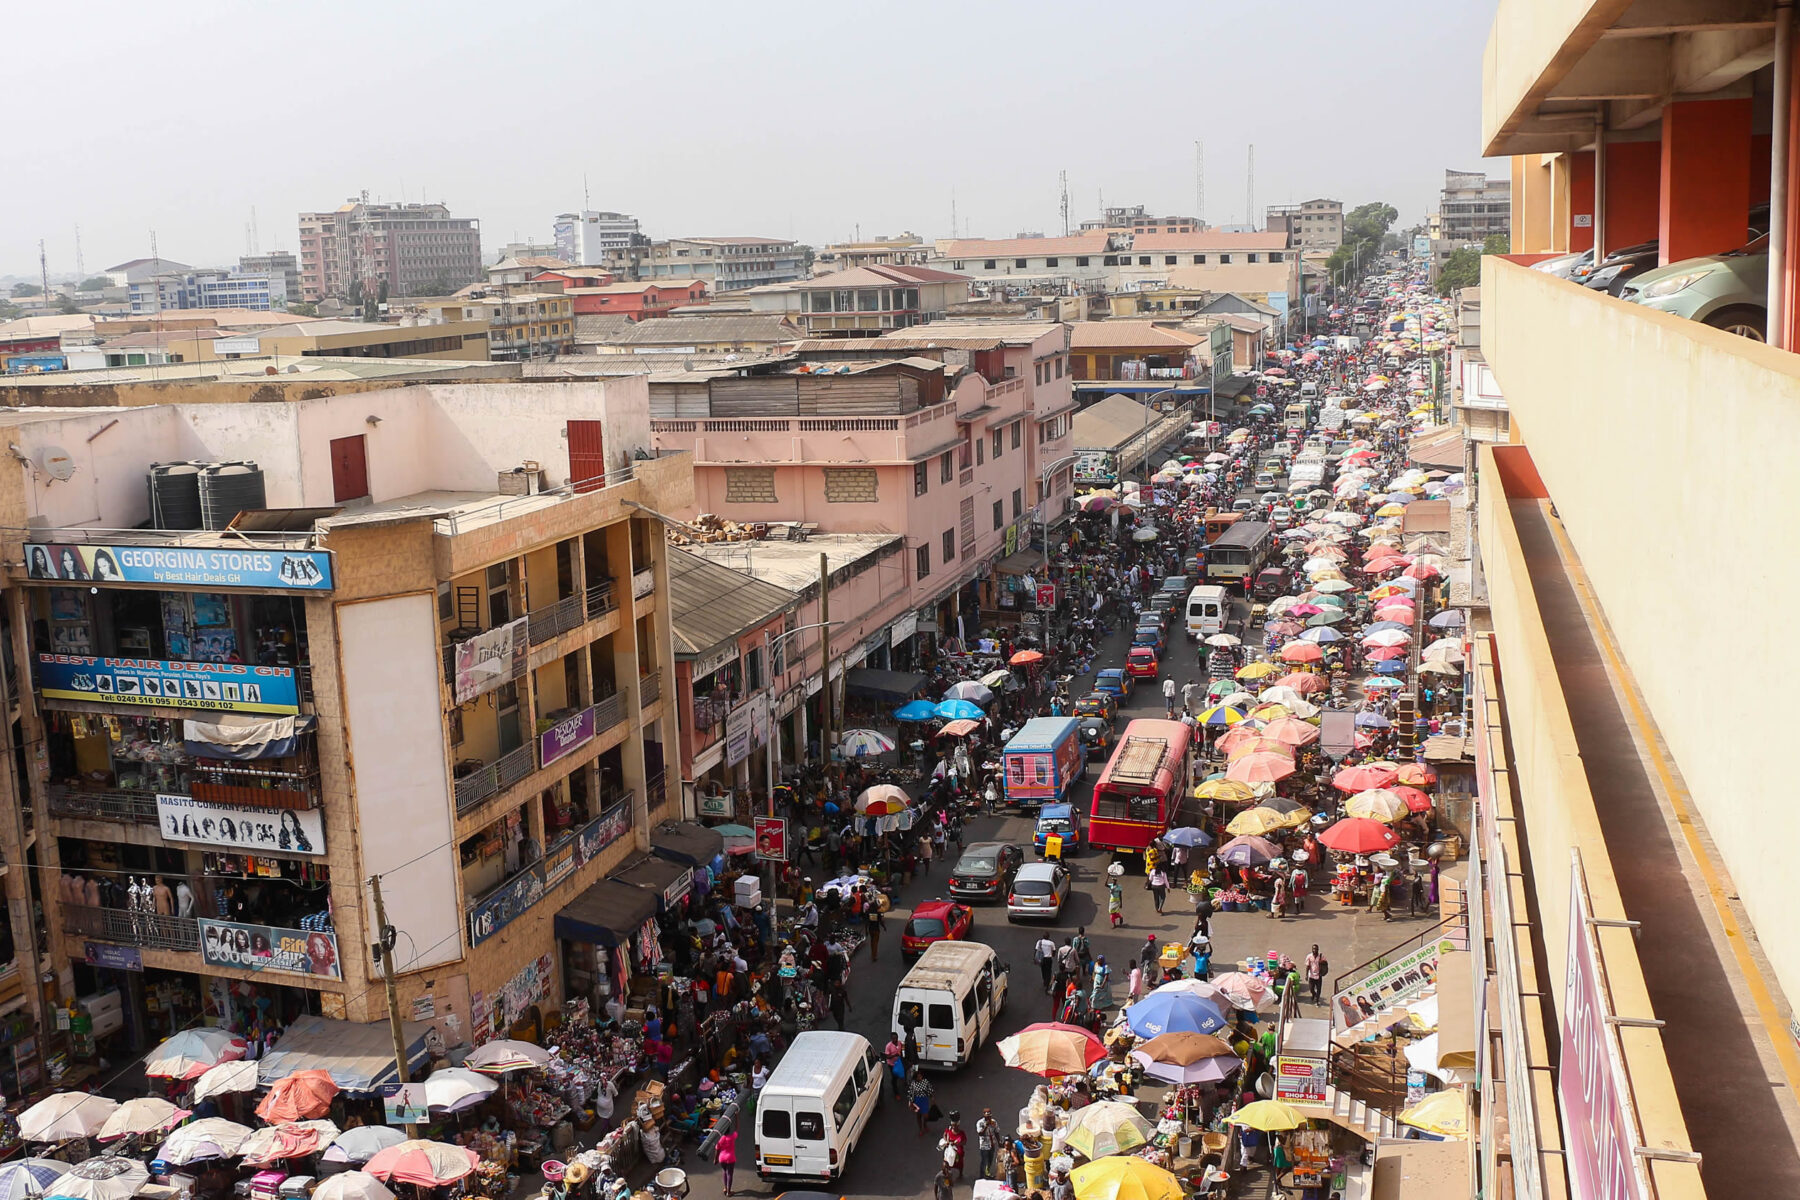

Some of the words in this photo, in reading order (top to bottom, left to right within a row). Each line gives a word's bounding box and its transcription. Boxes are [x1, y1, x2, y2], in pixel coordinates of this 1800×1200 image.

[121, 551, 207, 570] GEORGINA
[210, 553, 273, 572] STORES
[153, 571, 164, 581] by
[166, 571, 183, 581] Best
[185, 572, 201, 582] Hair
[203, 573, 226, 583] Deals
[227, 574, 241, 583] GH
[39, 653, 98, 666] BEST
[105, 657, 163, 670] HAIR
[169, 661, 247, 675] DEALS
[254, 665, 291, 678] GH
[116, 695, 137, 703] 0249
[160, 796, 195, 808] MASITO
[280, 936, 306, 953] Gift
[1365, 965, 1401, 988] AFRIPRIDE
[1400, 957, 1416, 968] WIG
[1416, 945, 1436, 959] SHOP
